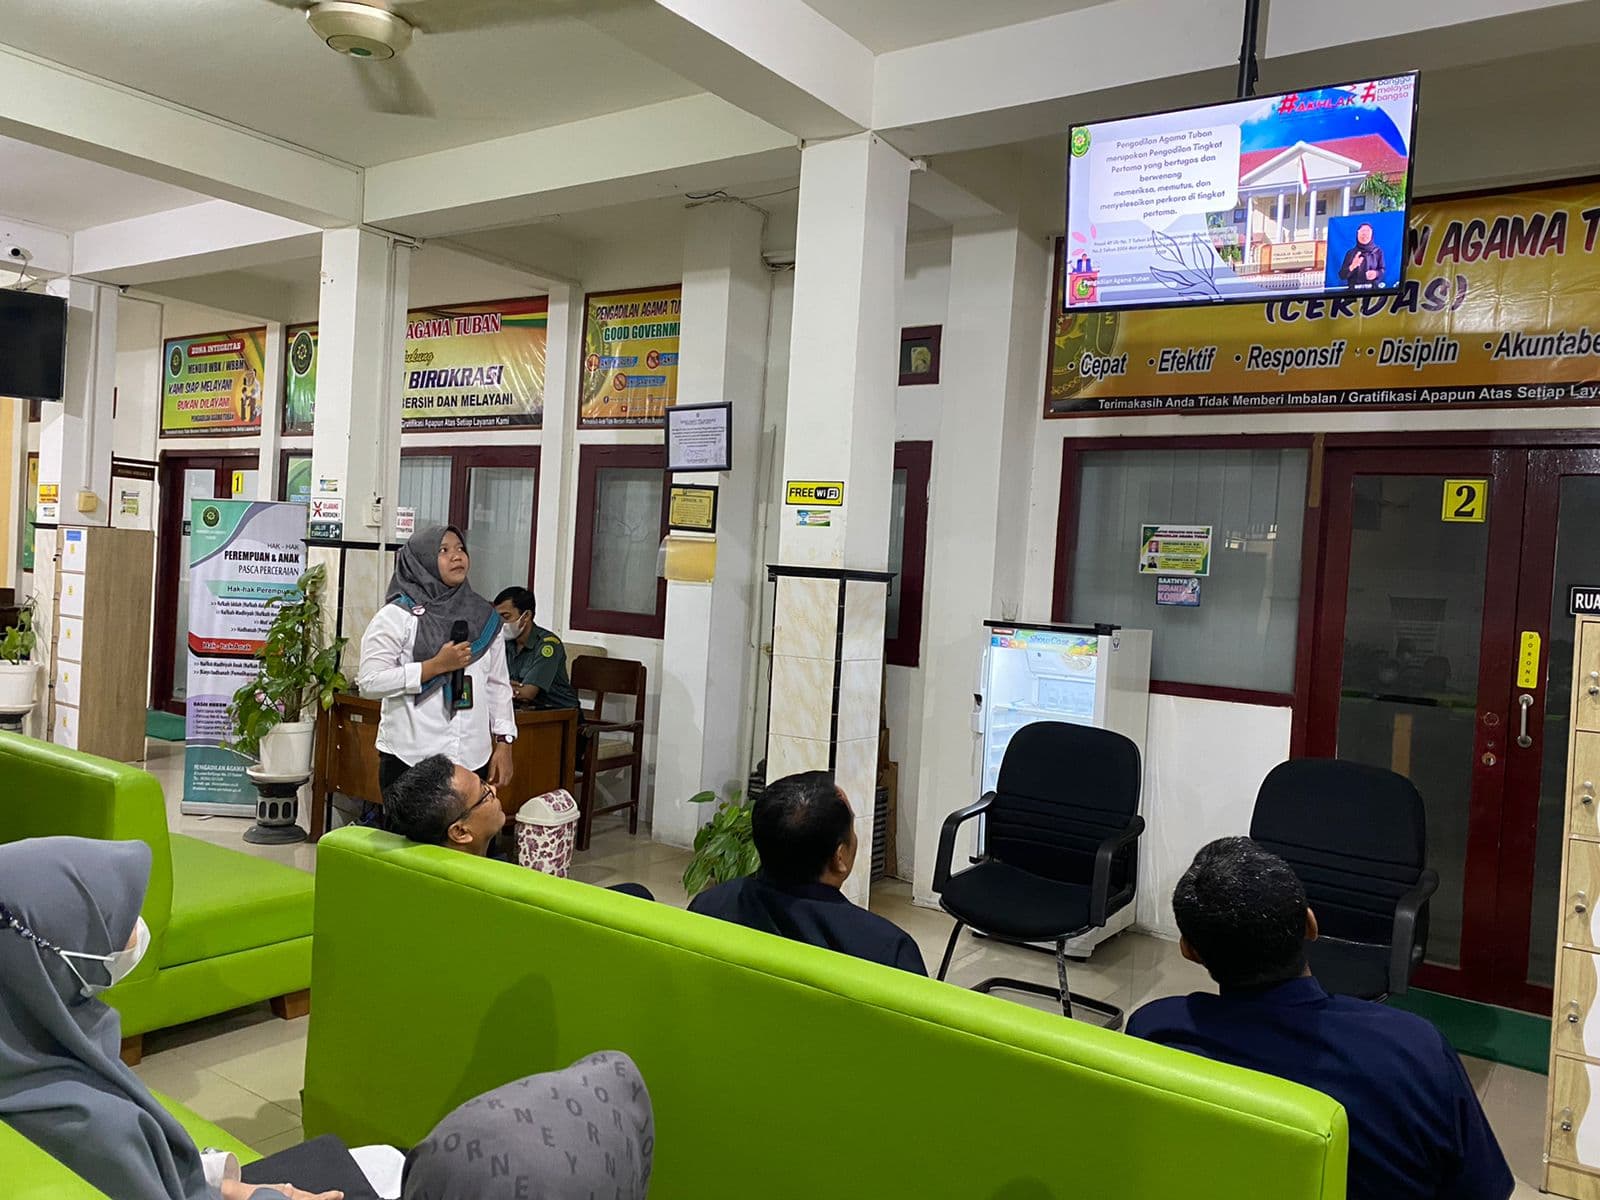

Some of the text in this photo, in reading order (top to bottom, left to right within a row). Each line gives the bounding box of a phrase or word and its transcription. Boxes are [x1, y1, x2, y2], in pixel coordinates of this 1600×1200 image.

[1116, 129, 1213, 149] Pengadilan Agama Tuban
[1106, 140, 1223, 164] merupakan Pengadilan Tingkat
[1111, 154, 1216, 174] Pertama yang bertugas dan
[1139, 171, 1183, 184] berwenang
[1196, 179, 1212, 188] dan
[1100, 189, 1226, 211] menyelesaikan perkara di tingkat
[1142, 208, 1178, 220] pertama.
[1436, 210, 1568, 265] AGAMA
[405, 313, 502, 340] AGAMA TUBAN
[604, 326, 630, 342] GOOD
[1081, 352, 1127, 381] Cepat
[1158, 347, 1216, 373] Efektif
[1246, 341, 1346, 376] Responsif
[1377, 336, 1459, 371] Disiplin
[168, 378, 233, 395] KAMI SIAP MELAYANI
[408, 365, 505, 390] BIROKRASI
[436, 395, 458, 408] DAN
[460, 393, 513, 407] MELAYANI
[1099, 397, 1164, 410] Terimakasih
[1165, 396, 1195, 408] Anda
[1197, 395, 1229, 407] Tidak
[1232, 393, 1285, 406] Memberi
[1287, 391, 1337, 405] Imbalan
[1348, 389, 1417, 403] Gratifikasi
[1420, 388, 1477, 404] Apapun
[1479, 386, 1512, 399] Atas
[1516, 384, 1565, 402] Setiap
[789, 487, 815, 498] FREE
[1454, 484, 1476, 518] 2
[286, 543, 299, 551] HAK
[224, 550, 300, 564] PEREMPUAN & ANAK
[238, 564, 299, 577] PASCA PERCERAIAN
[227, 585, 256, 594] Hak-hak
[1523, 633, 1534, 684] DORONG
